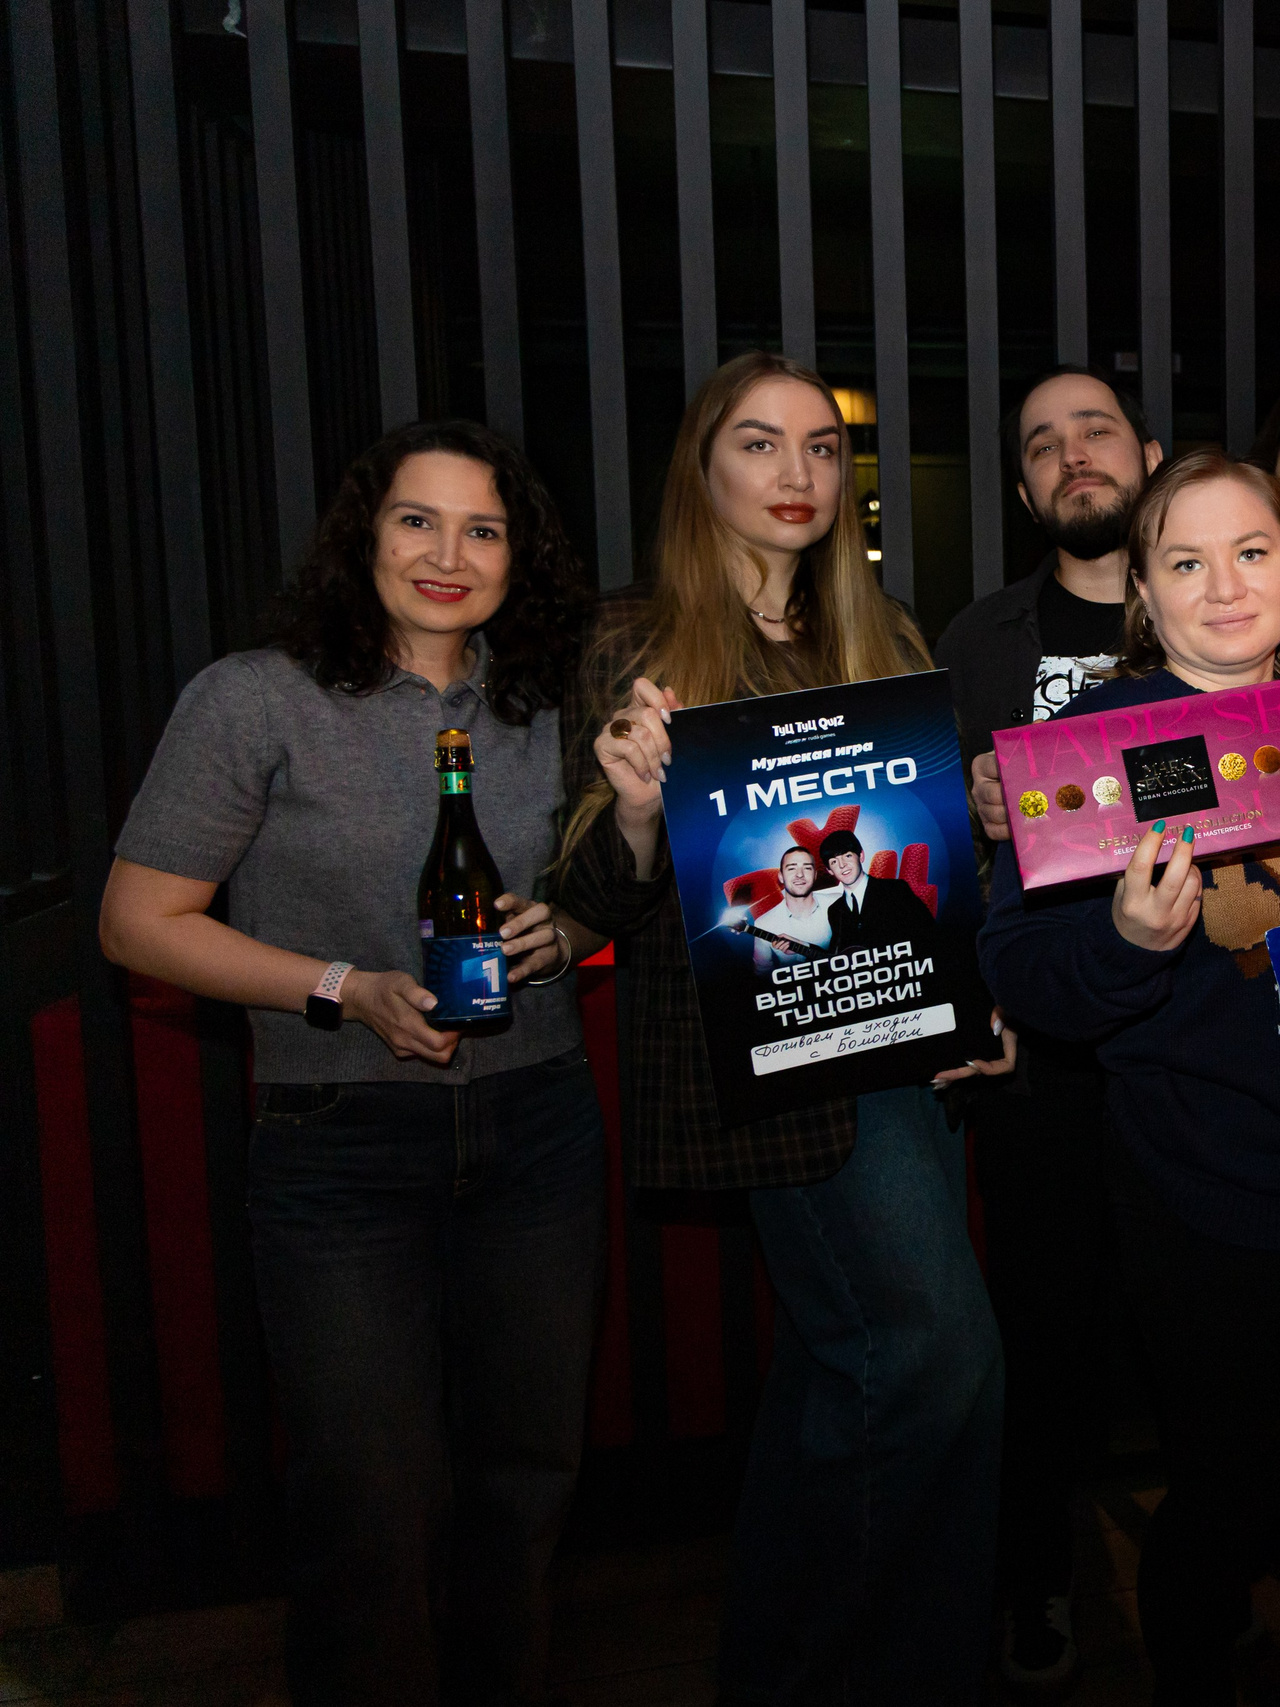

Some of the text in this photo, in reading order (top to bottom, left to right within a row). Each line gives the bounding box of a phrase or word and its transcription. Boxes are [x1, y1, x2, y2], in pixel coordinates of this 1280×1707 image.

[751, 741, 873, 771] Мужская игра
[709, 757, 918, 817] 1 МЕСТО
[1138, 783, 1208, 802] URBAN CHOCOLATIER
[1195, 809, 1263, 830] COLLECTION
[1203, 823, 1252, 838] MASTERPIECES
[482, 957, 500, 993] 1
[771, 940, 913, 985] СЕГОДНЯ
[755, 957, 934, 1011] ВЫ КОРОЛИ
[774, 981, 922, 1027] ТУЦОВКИ!
[754, 1012, 922, 1057] Допиваем и уходим
[809, 1027, 924, 1059] с Бомондом
